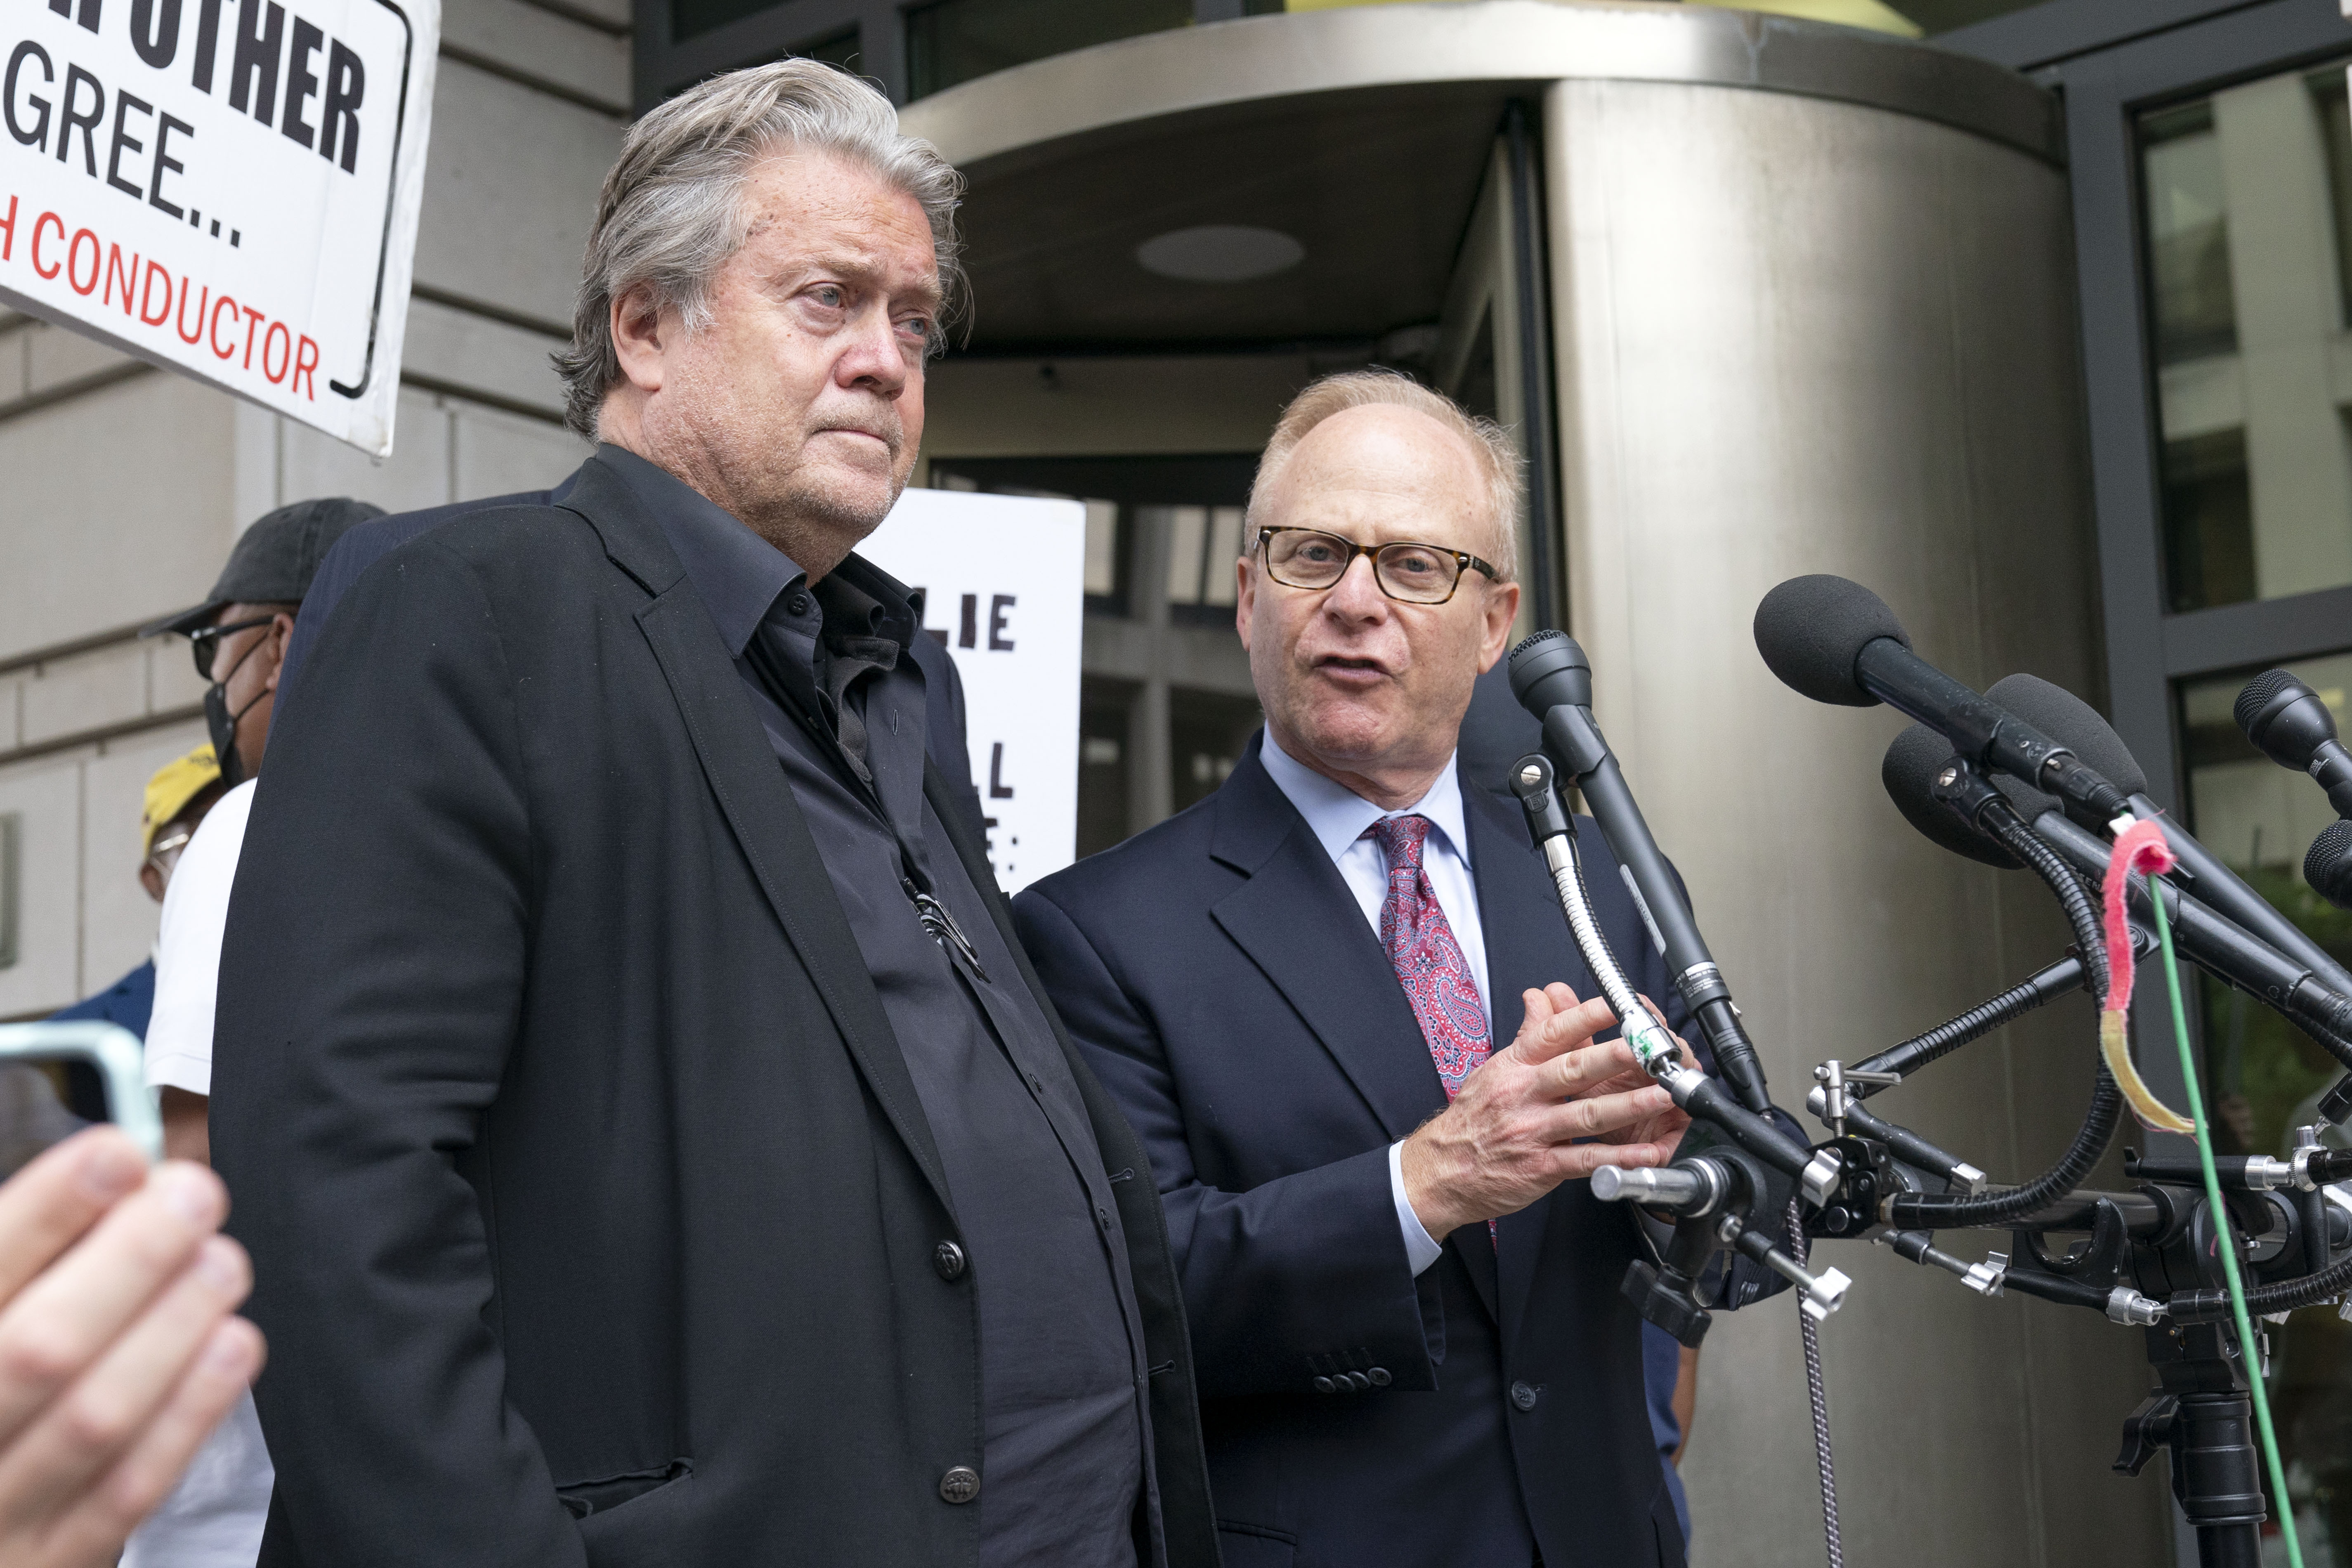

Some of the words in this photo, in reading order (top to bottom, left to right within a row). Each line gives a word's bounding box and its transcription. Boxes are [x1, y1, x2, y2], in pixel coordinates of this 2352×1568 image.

[130, 0, 366, 176] OTHER
[31, 211, 319, 401] CONDUCTOR
[912, 587, 1015, 651] IE
